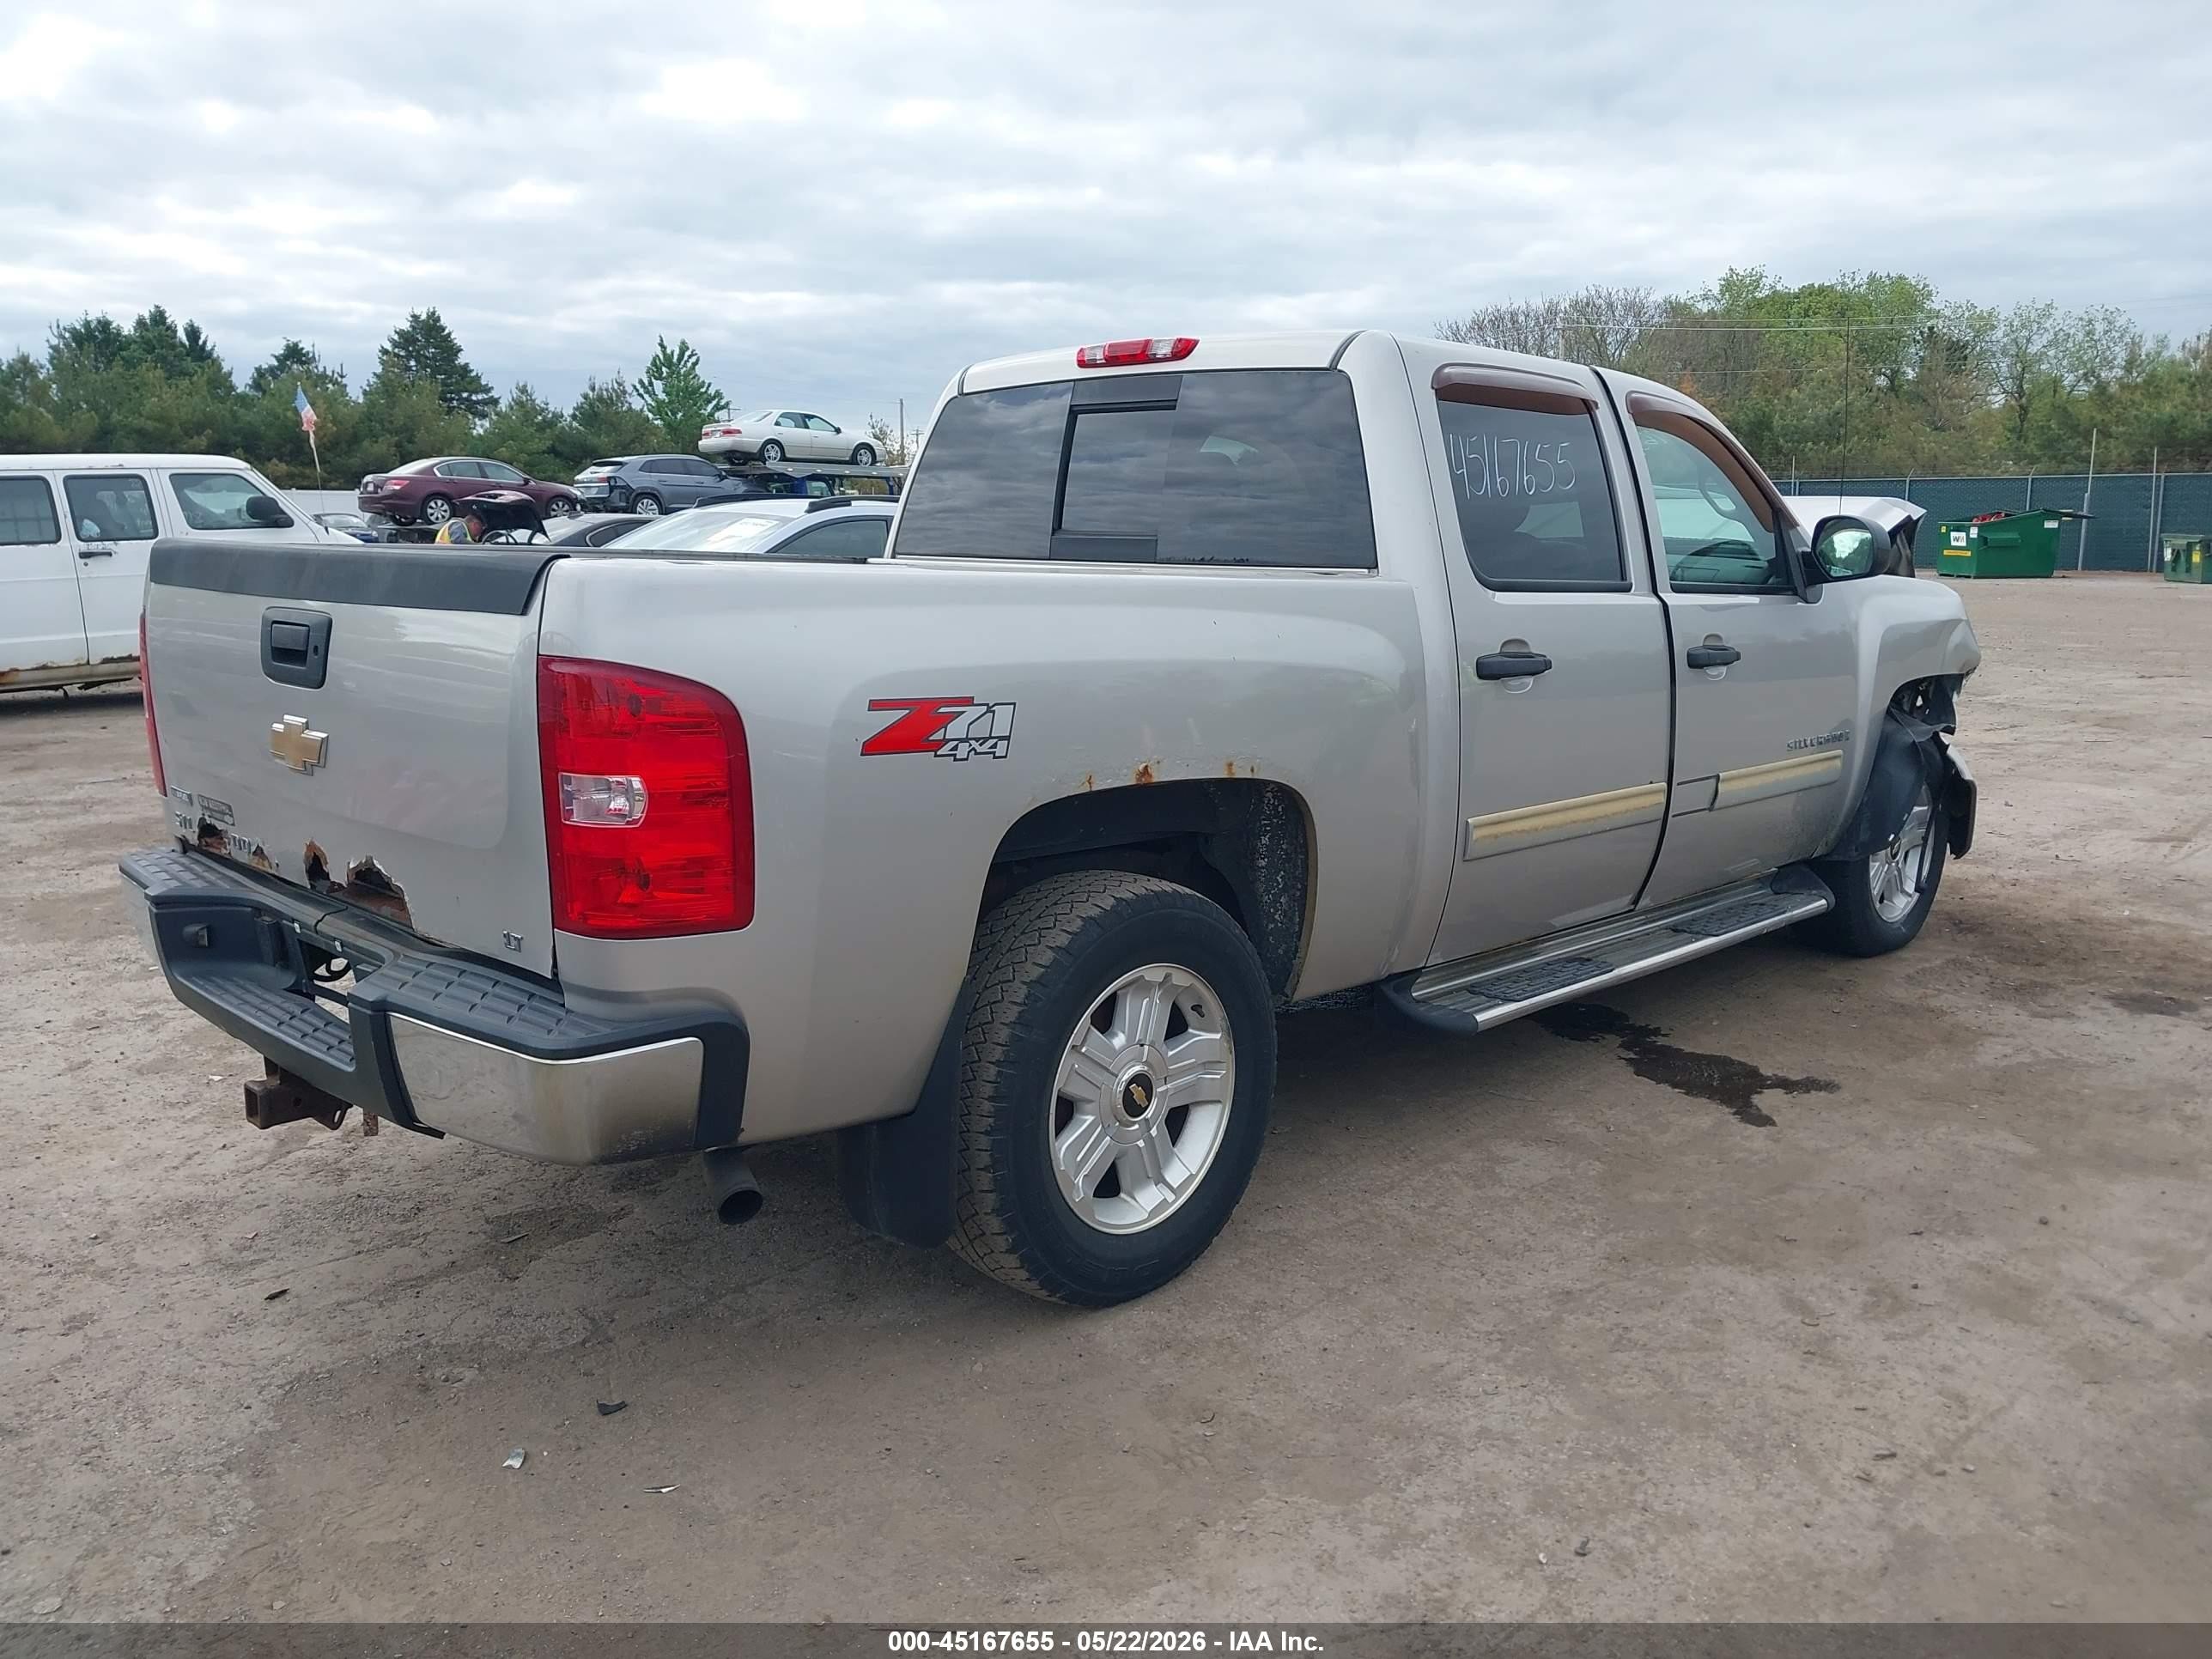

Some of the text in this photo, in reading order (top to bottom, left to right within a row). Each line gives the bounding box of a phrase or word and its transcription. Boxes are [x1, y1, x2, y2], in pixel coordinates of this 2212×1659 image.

[1449, 433, 1577, 501] 45167655
[860, 696, 1017, 757] Z71
[502, 930, 524, 953] LT
